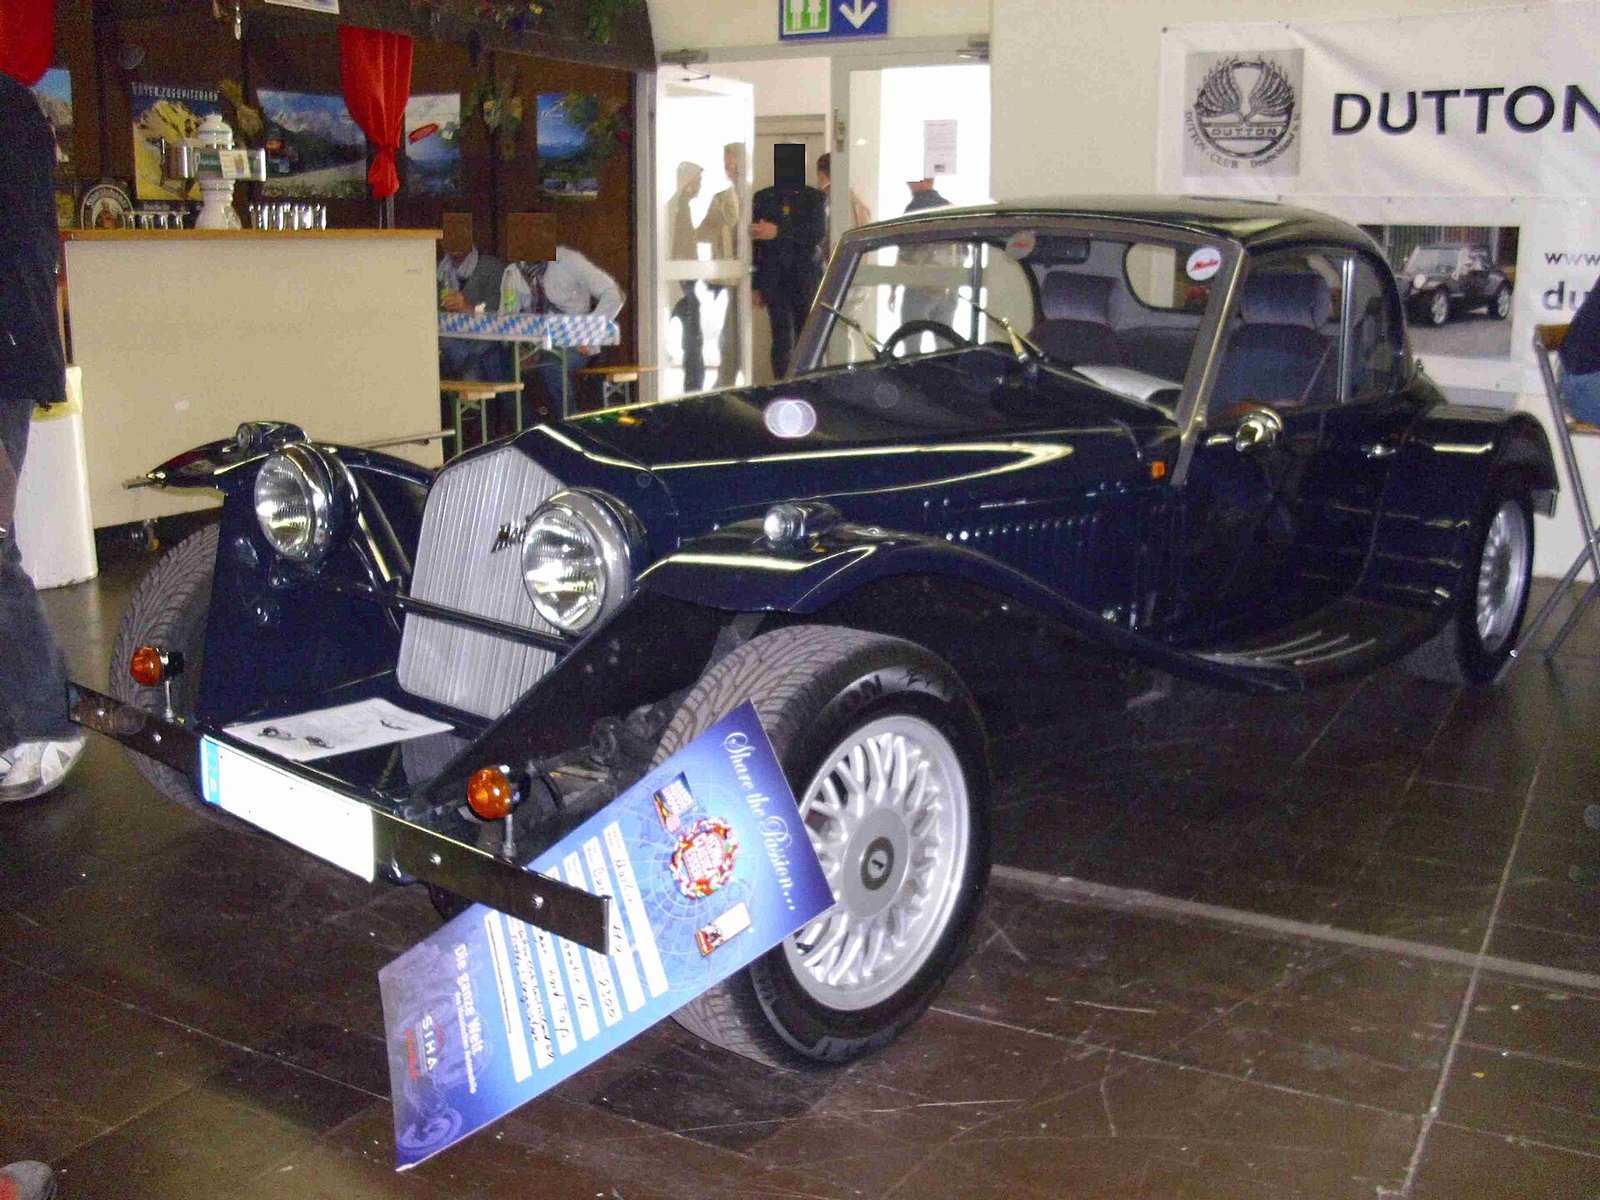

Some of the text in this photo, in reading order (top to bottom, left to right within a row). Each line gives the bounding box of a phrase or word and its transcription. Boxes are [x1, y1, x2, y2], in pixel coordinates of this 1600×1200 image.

[1211, 128, 1277, 137] DUTTON
[1331, 85, 1600, 137] DUTTON
[722, 732, 756, 789] Share
[747, 793, 771, 817] the
[454, 943, 484, 1056] Die ganze Welt
[422, 1015, 438, 1072] SIHA
